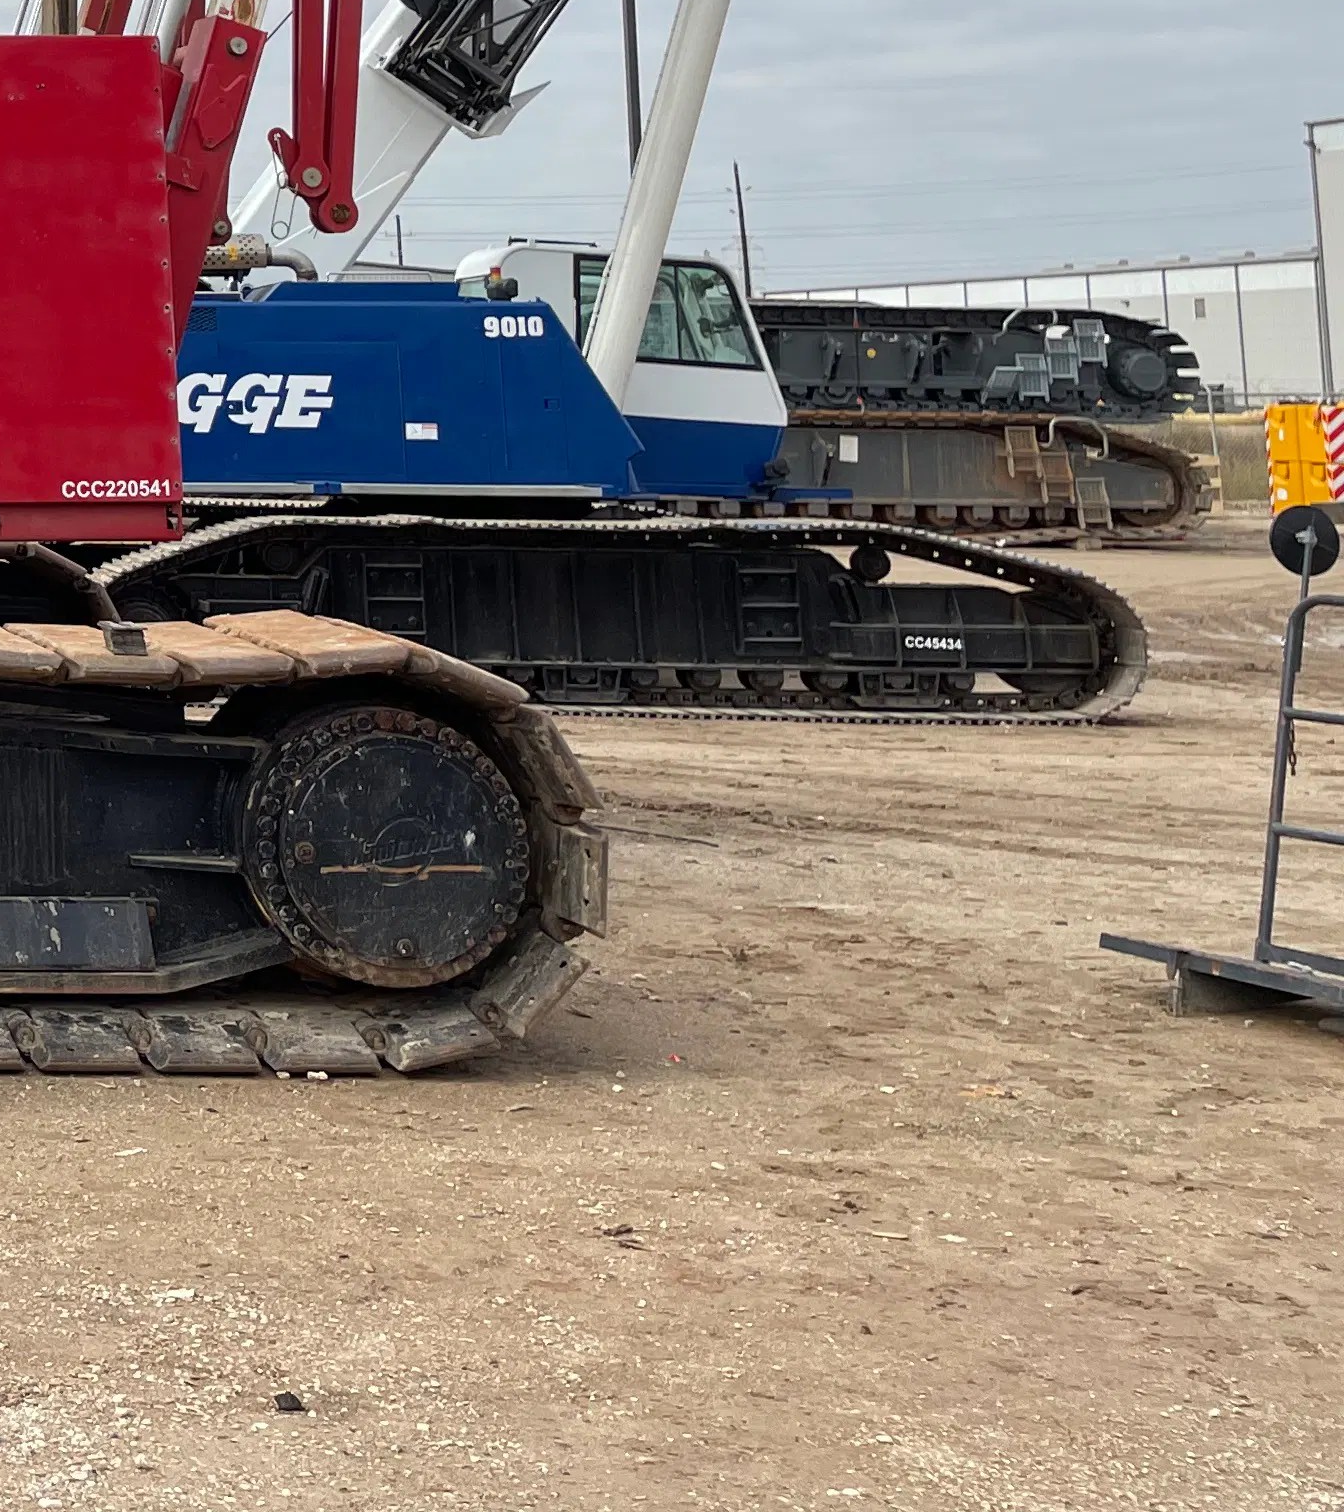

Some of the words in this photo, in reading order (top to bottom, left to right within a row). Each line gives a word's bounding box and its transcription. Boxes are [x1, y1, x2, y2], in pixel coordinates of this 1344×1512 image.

[483, 315, 544, 338] 9010
[61, 479, 171, 498] CCC220541
[904, 635, 962, 650] CC45434
